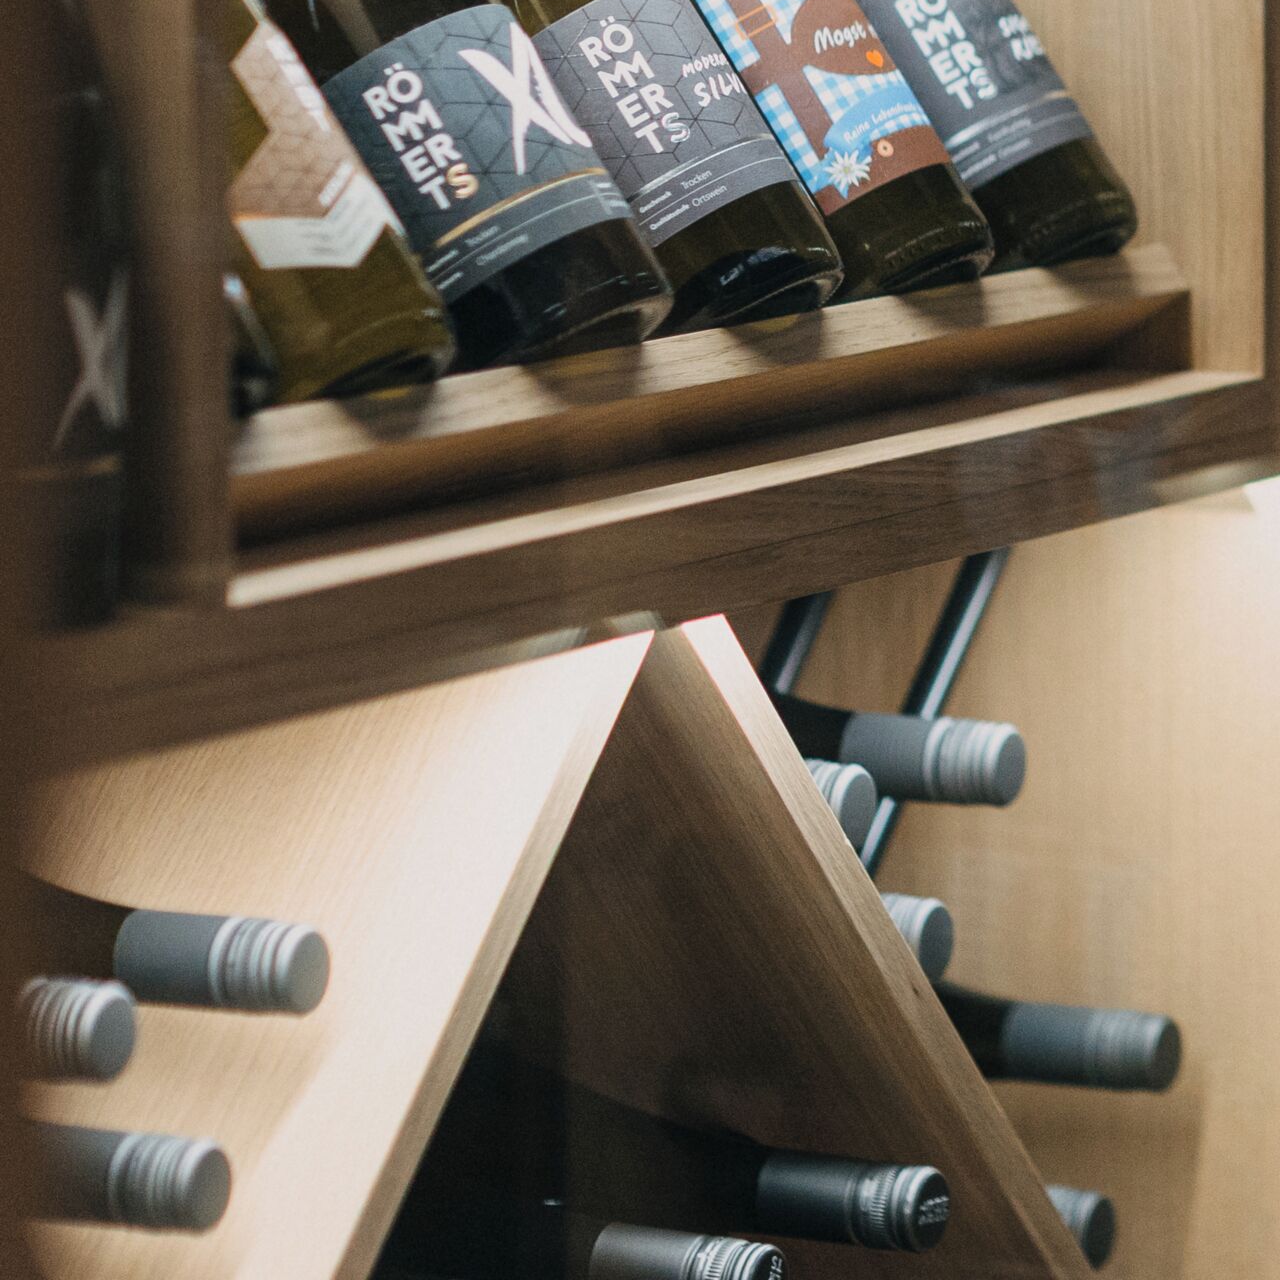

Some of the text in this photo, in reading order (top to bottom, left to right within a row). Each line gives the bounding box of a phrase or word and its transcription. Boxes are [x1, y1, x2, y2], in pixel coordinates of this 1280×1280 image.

[813, 20, 867, 55] Mogst
[693, 72, 748, 108] SILV
[680, 169, 713, 191] Trocken
[691, 183, 728, 208] Ortswein
